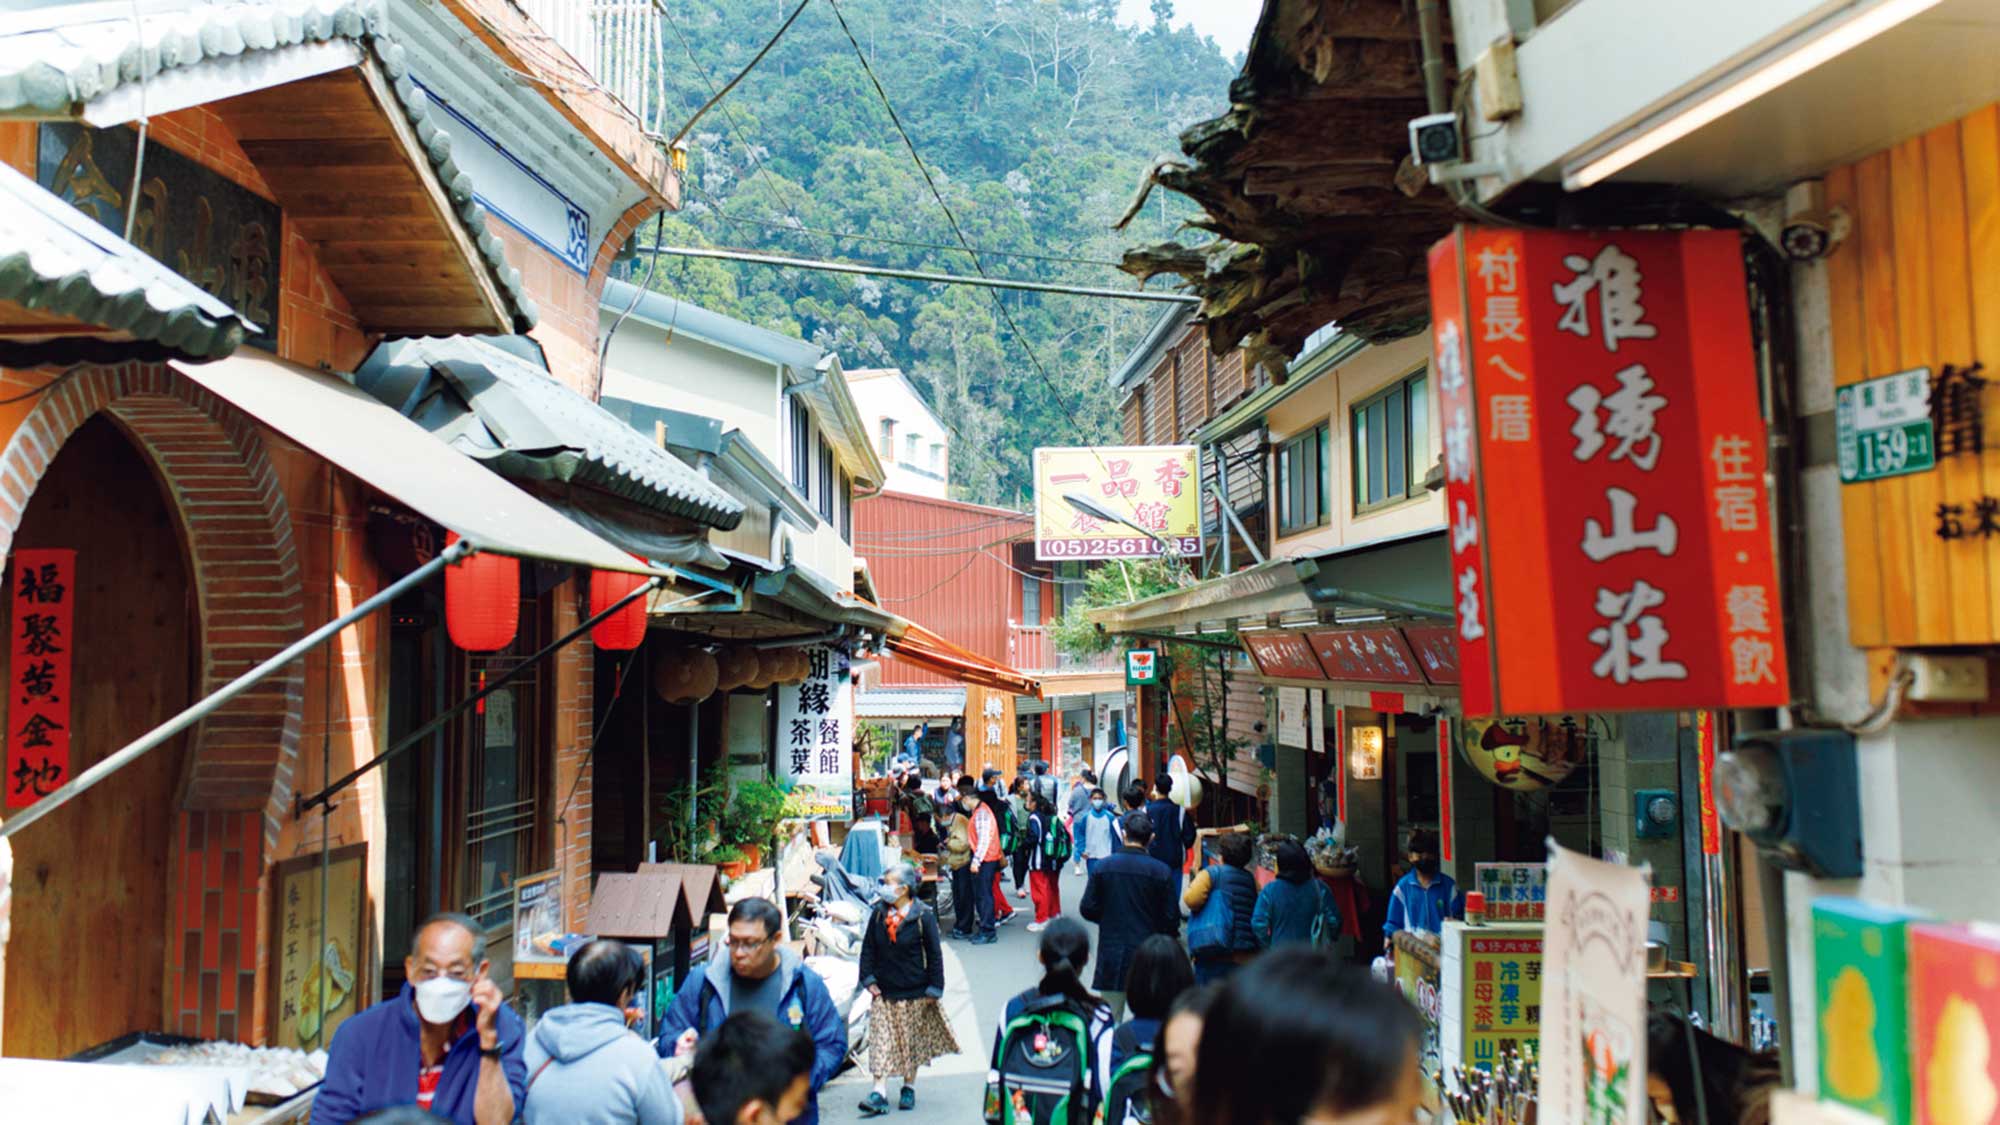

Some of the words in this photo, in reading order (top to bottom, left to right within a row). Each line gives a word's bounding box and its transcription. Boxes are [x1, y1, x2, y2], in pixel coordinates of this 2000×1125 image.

[1049, 458, 1189, 498] 一品香
[790, 718, 811, 776] 茶葉
[818, 718, 840, 775] 餐館
